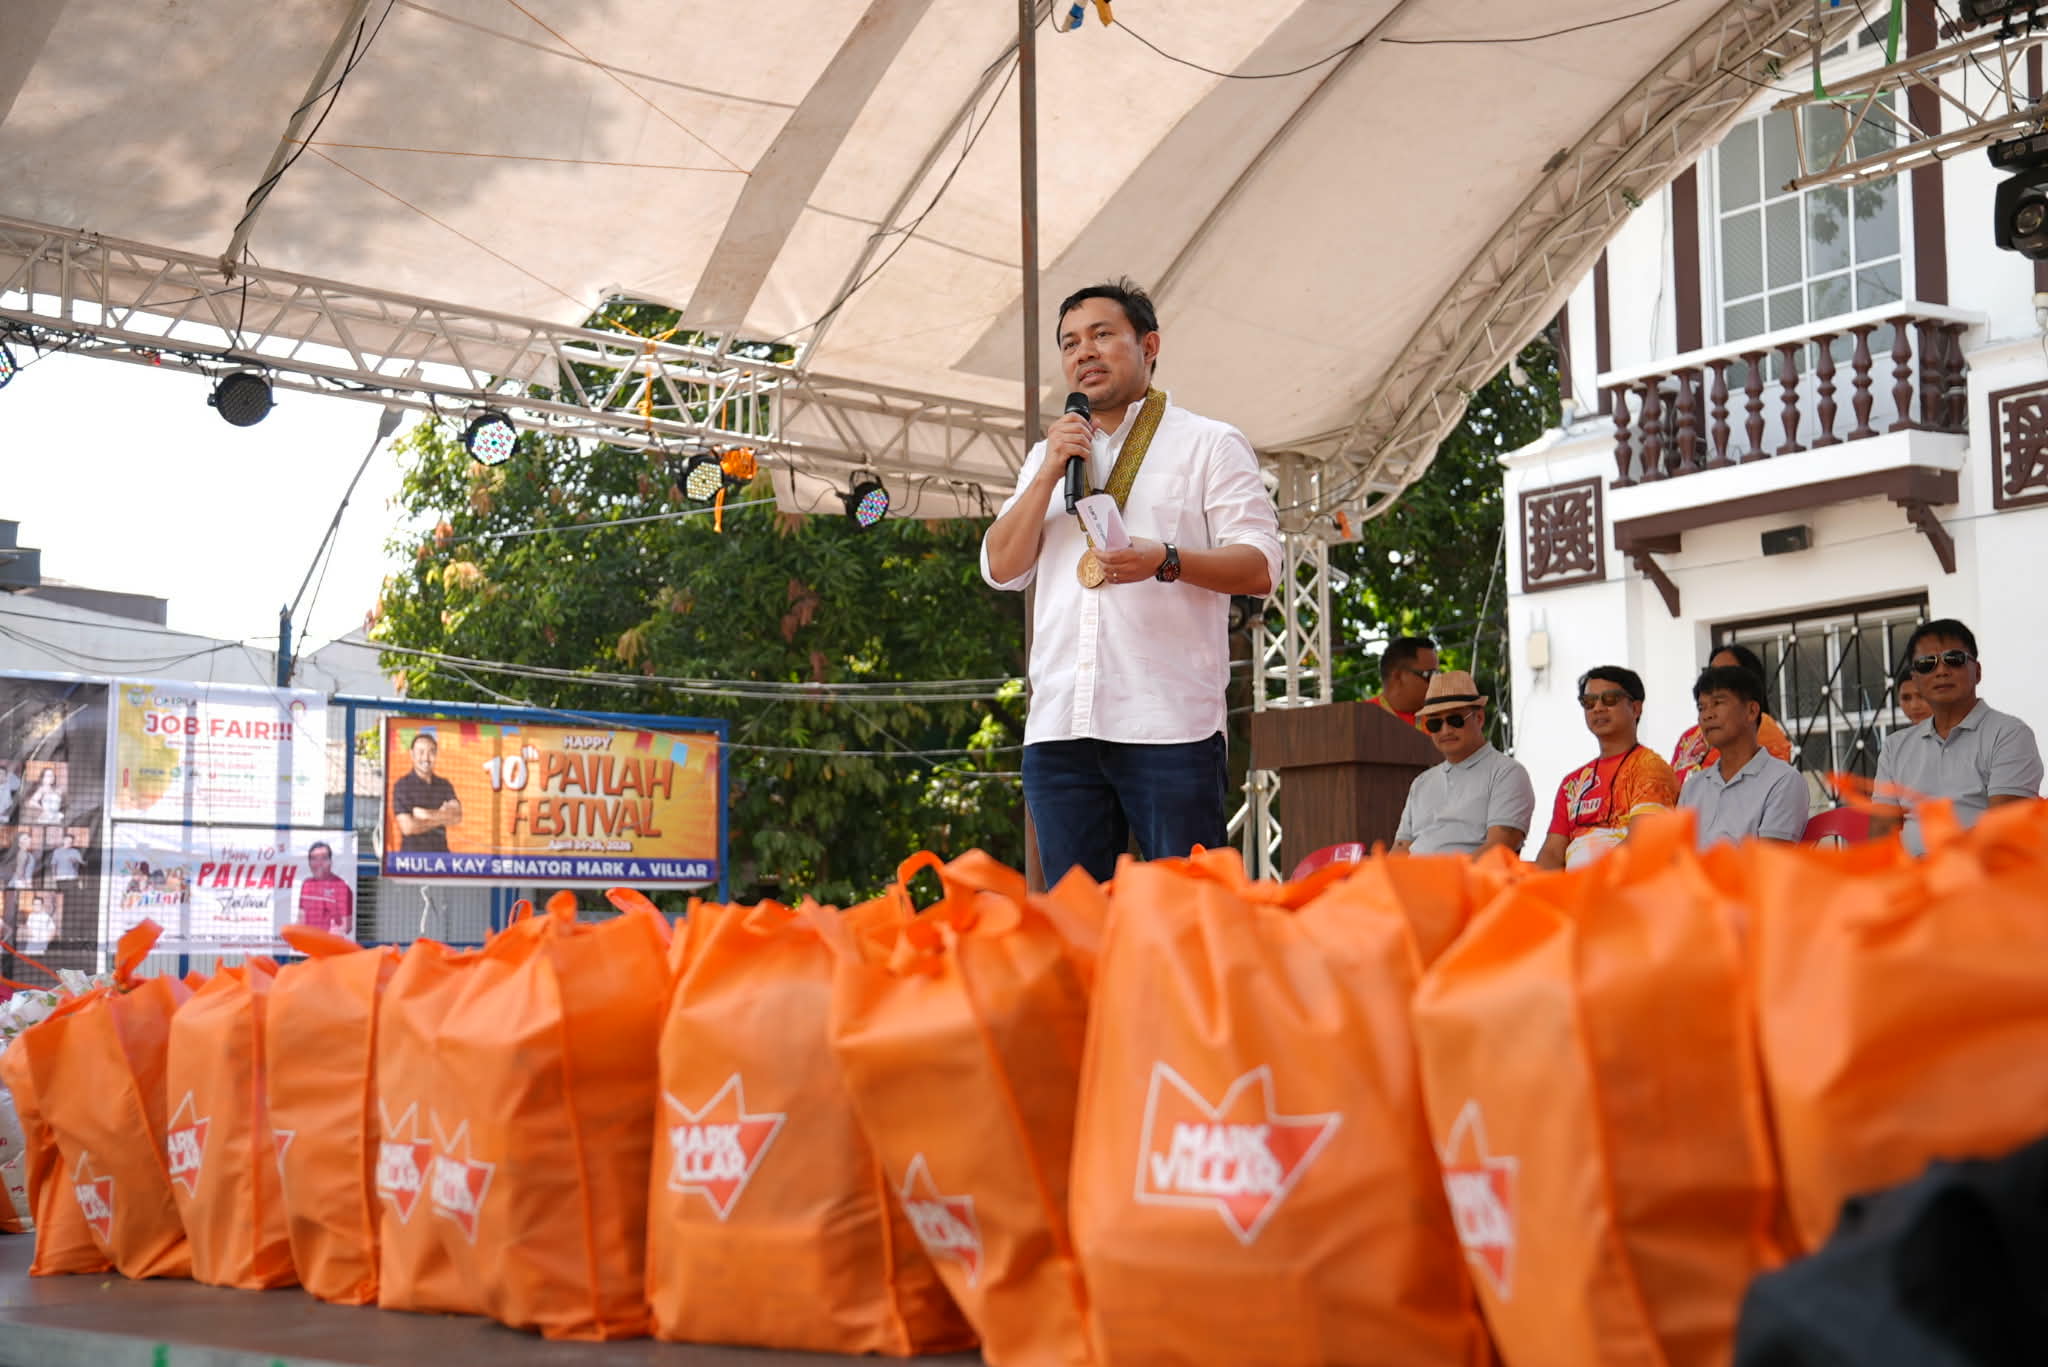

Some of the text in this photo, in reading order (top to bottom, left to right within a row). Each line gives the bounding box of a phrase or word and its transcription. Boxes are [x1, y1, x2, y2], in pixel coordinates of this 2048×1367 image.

[146, 714, 293, 741] JOB FAIR!!!
[563, 735, 612, 750] HAPPY
[483, 745, 675, 800] 10th PAILAH
[511, 797, 662, 838] FESTIVAL
[196, 862, 297, 889] PAILAH
[395, 857, 708, 877] MULA KAY SENATOR MARK A. VILLAR
[1174, 1122, 1271, 1157] MARK
[1151, 1150, 1284, 1195] VILLAR
